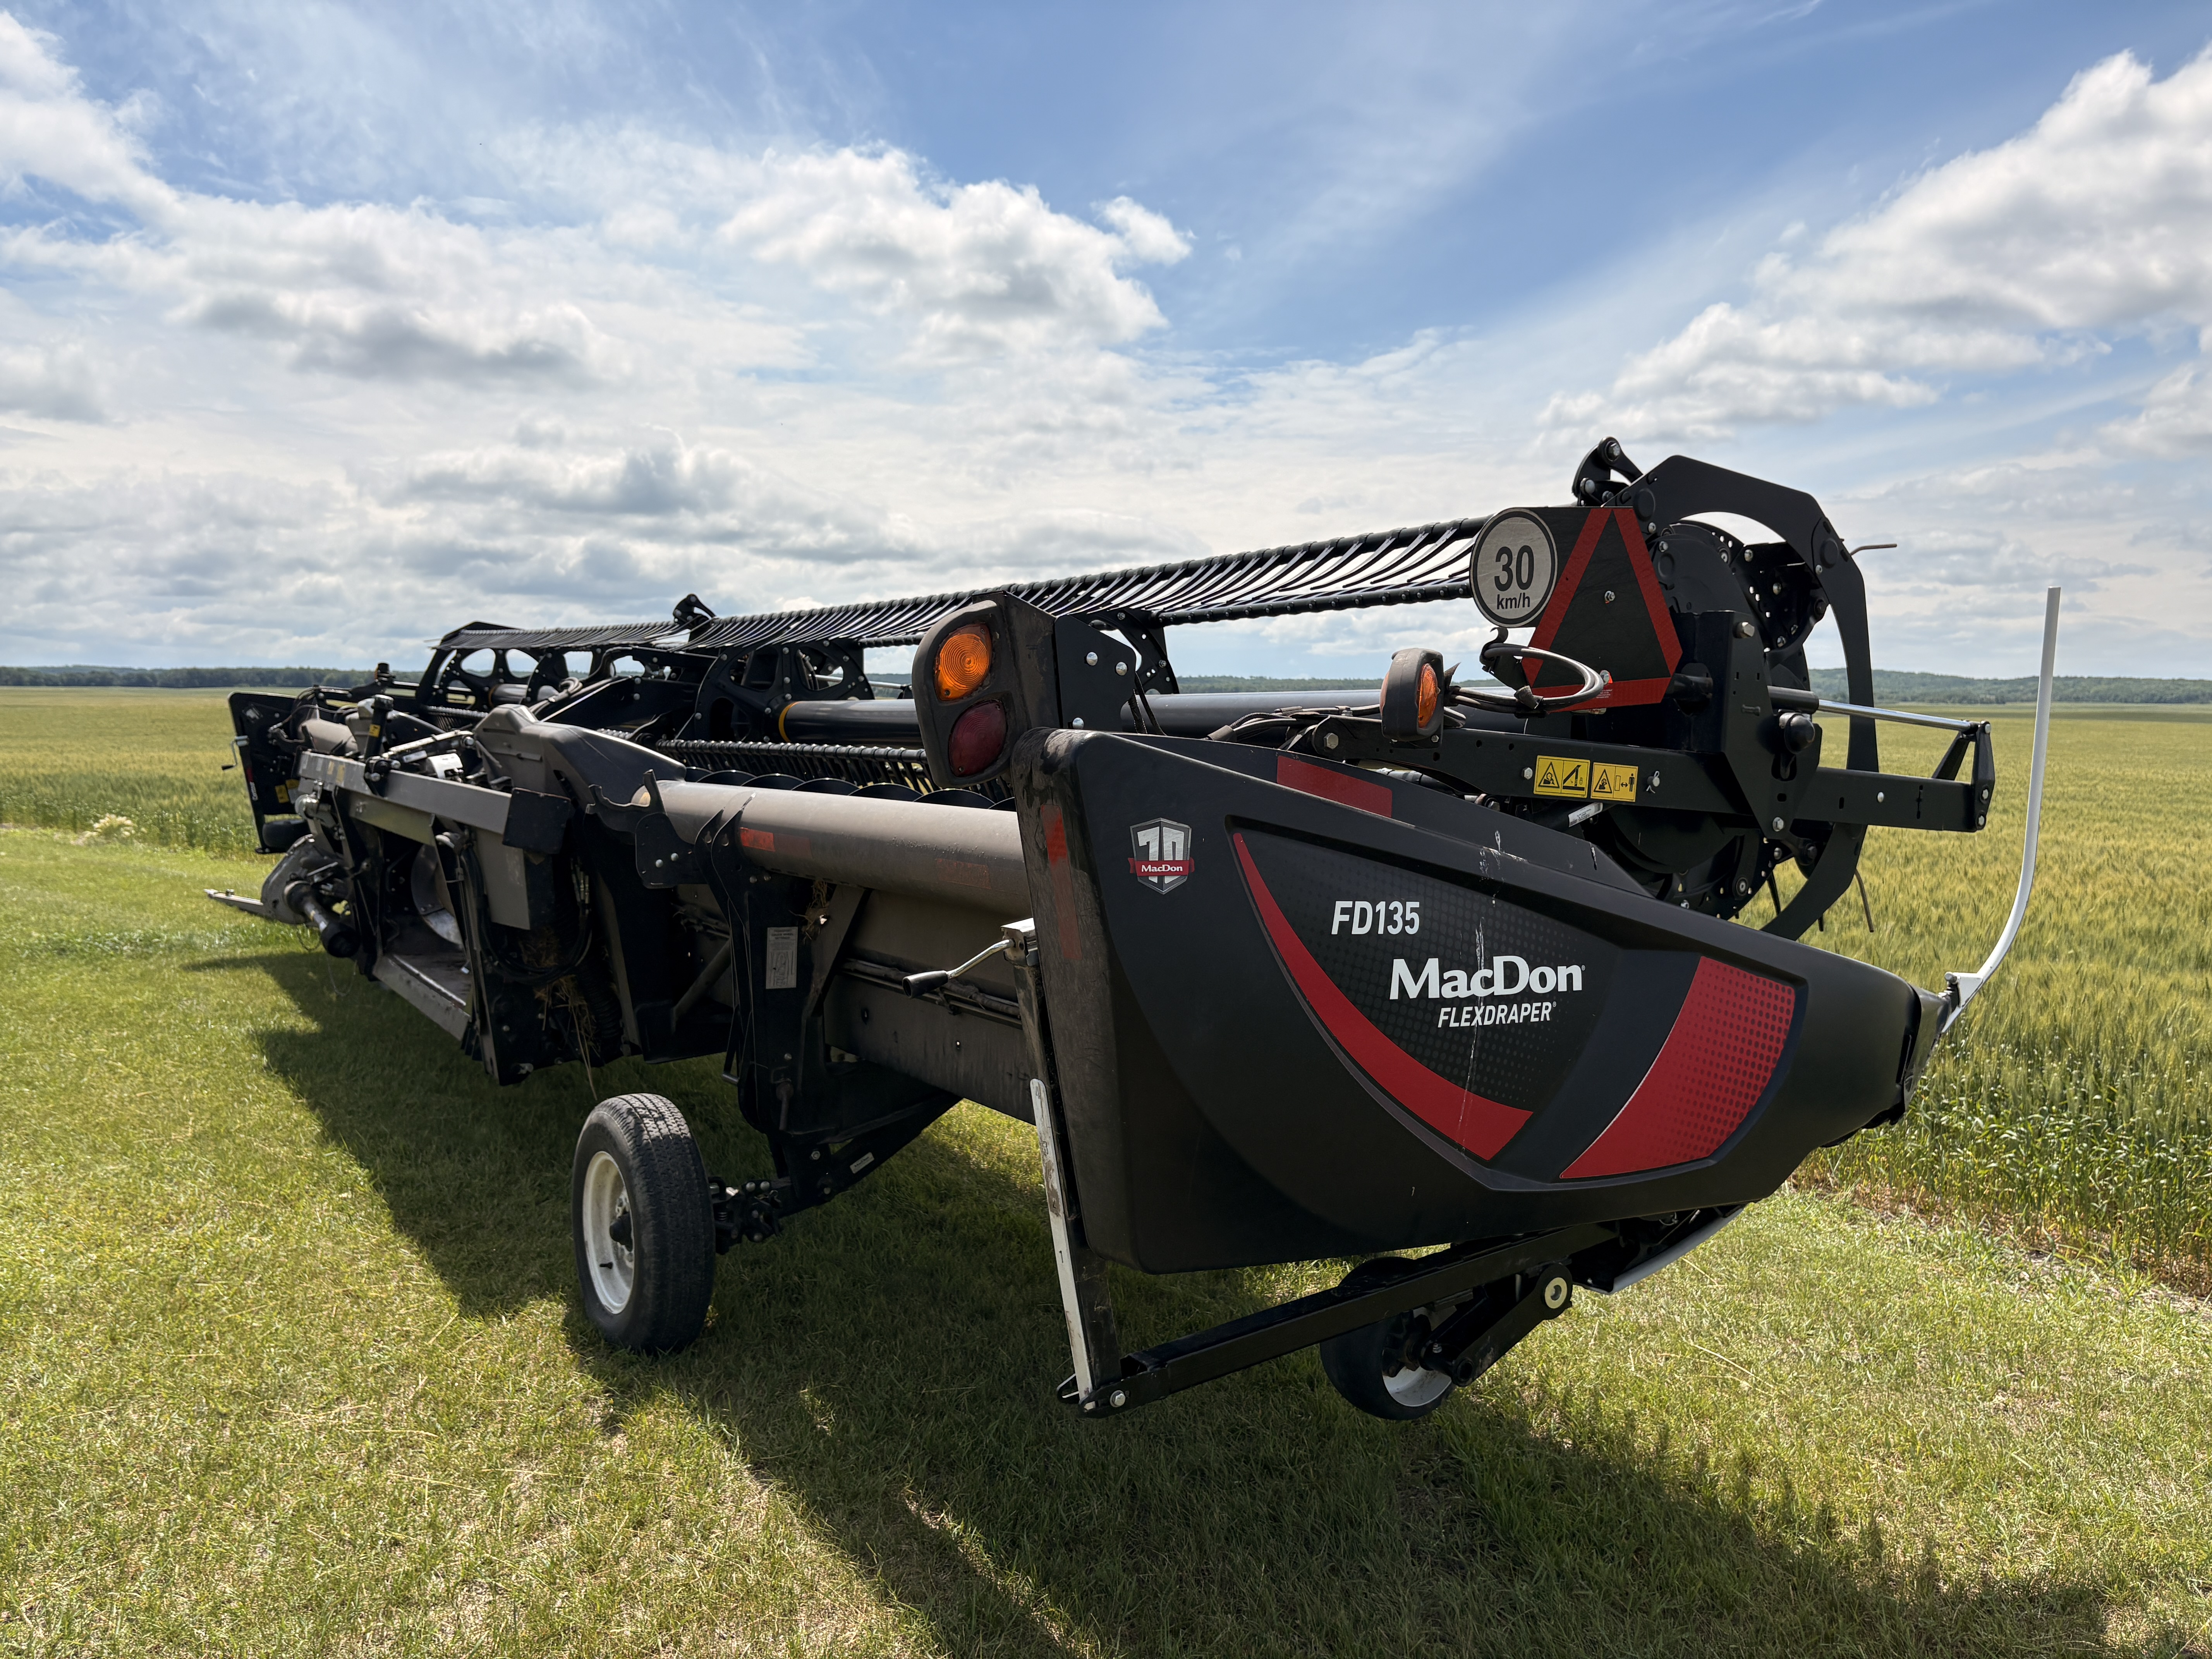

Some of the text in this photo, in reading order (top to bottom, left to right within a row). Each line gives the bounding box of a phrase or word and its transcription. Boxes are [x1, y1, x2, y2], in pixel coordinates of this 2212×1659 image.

[1494, 545, 1534, 591] 30
[1497, 592, 1530, 610] km/h
[1331, 901, 1420, 934] FD135
